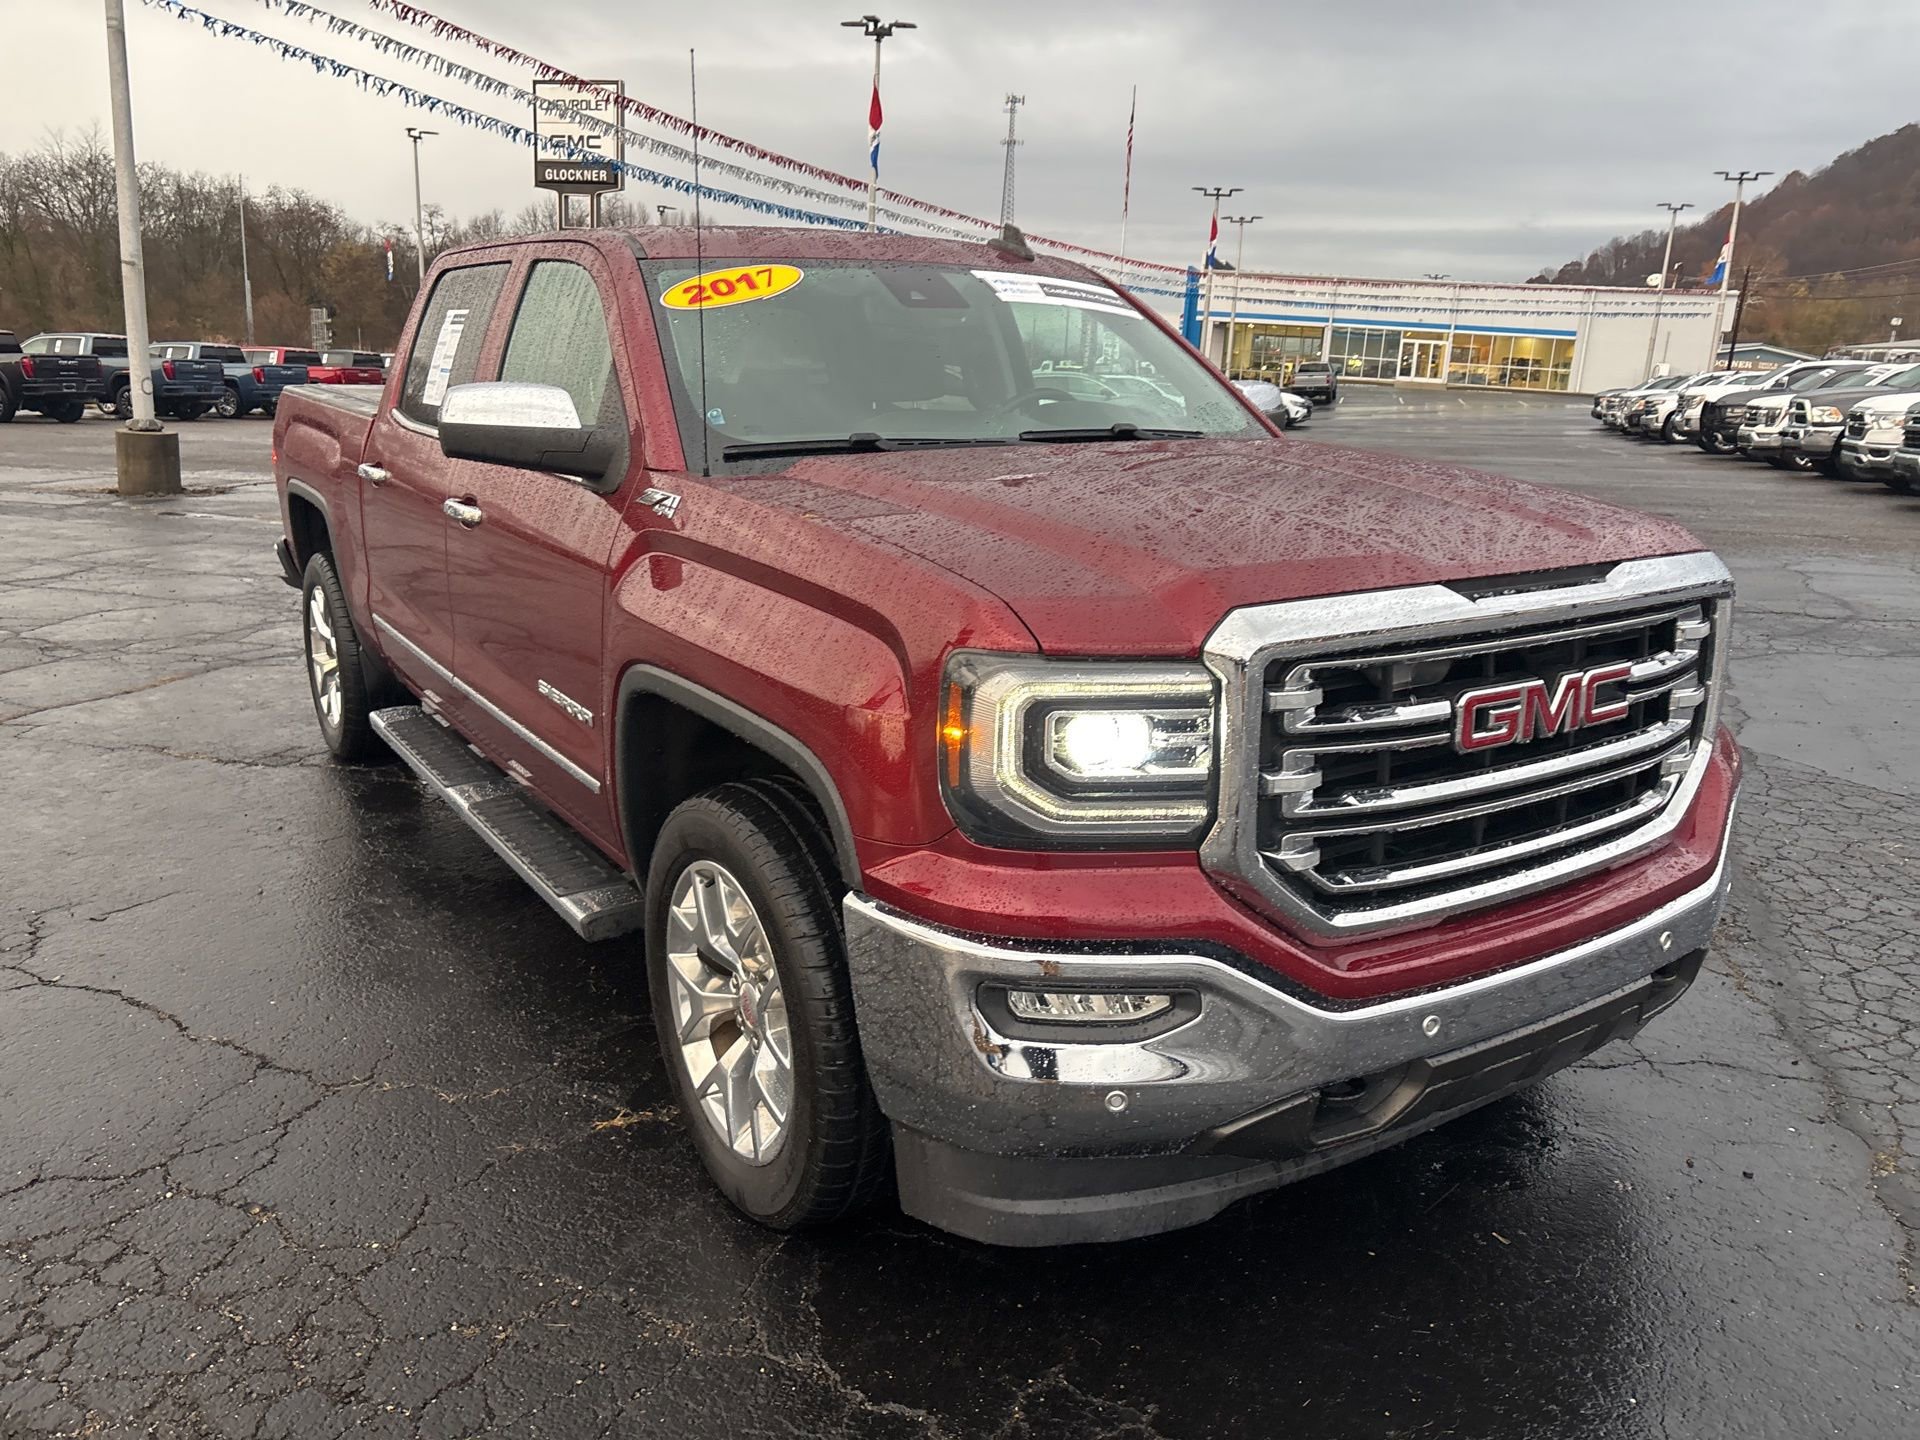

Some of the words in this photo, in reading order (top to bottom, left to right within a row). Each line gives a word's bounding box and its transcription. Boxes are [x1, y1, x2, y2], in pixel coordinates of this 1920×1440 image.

[544, 168, 607, 181] GLOCKNER
[682, 268, 773, 305] 2017
[537, 678, 594, 728] SIERRA
[1454, 661, 1633, 755] GMC
